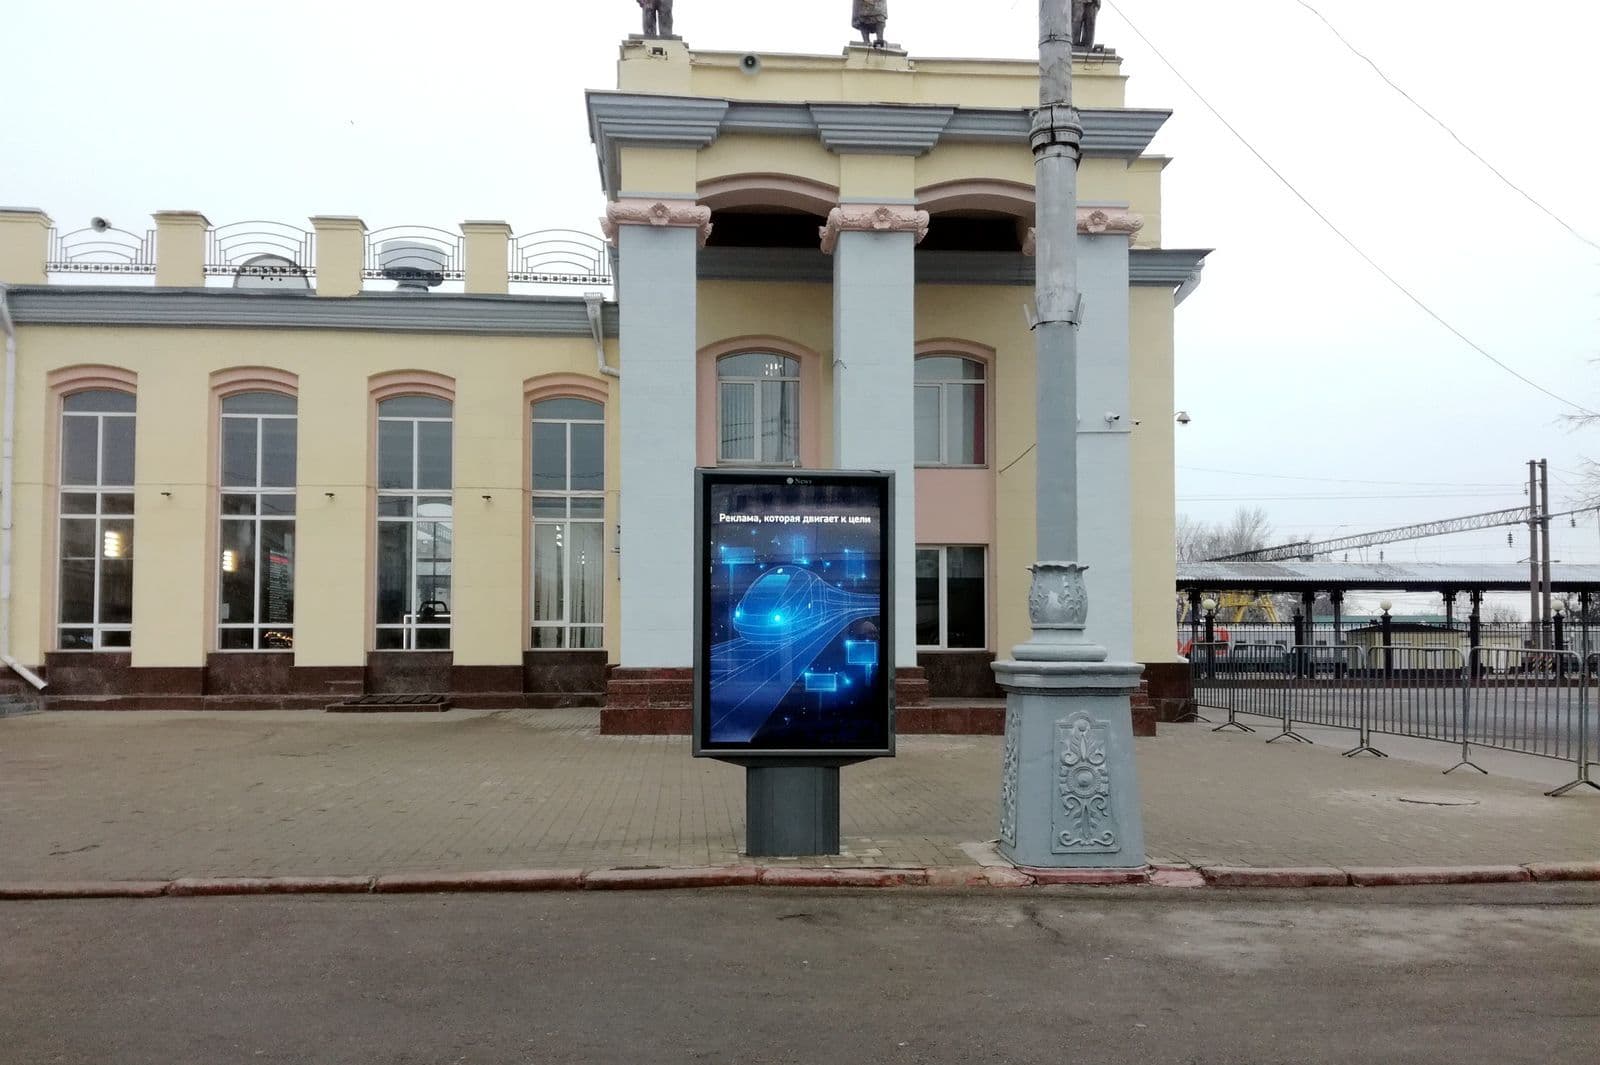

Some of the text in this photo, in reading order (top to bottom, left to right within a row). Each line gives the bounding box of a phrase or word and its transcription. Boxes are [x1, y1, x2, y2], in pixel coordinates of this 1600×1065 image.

[719, 513, 762, 524] Реклама,
[763, 515, 801, 525] которая
[802, 515, 839, 524] двигает
[848, 516, 872, 525] цели
